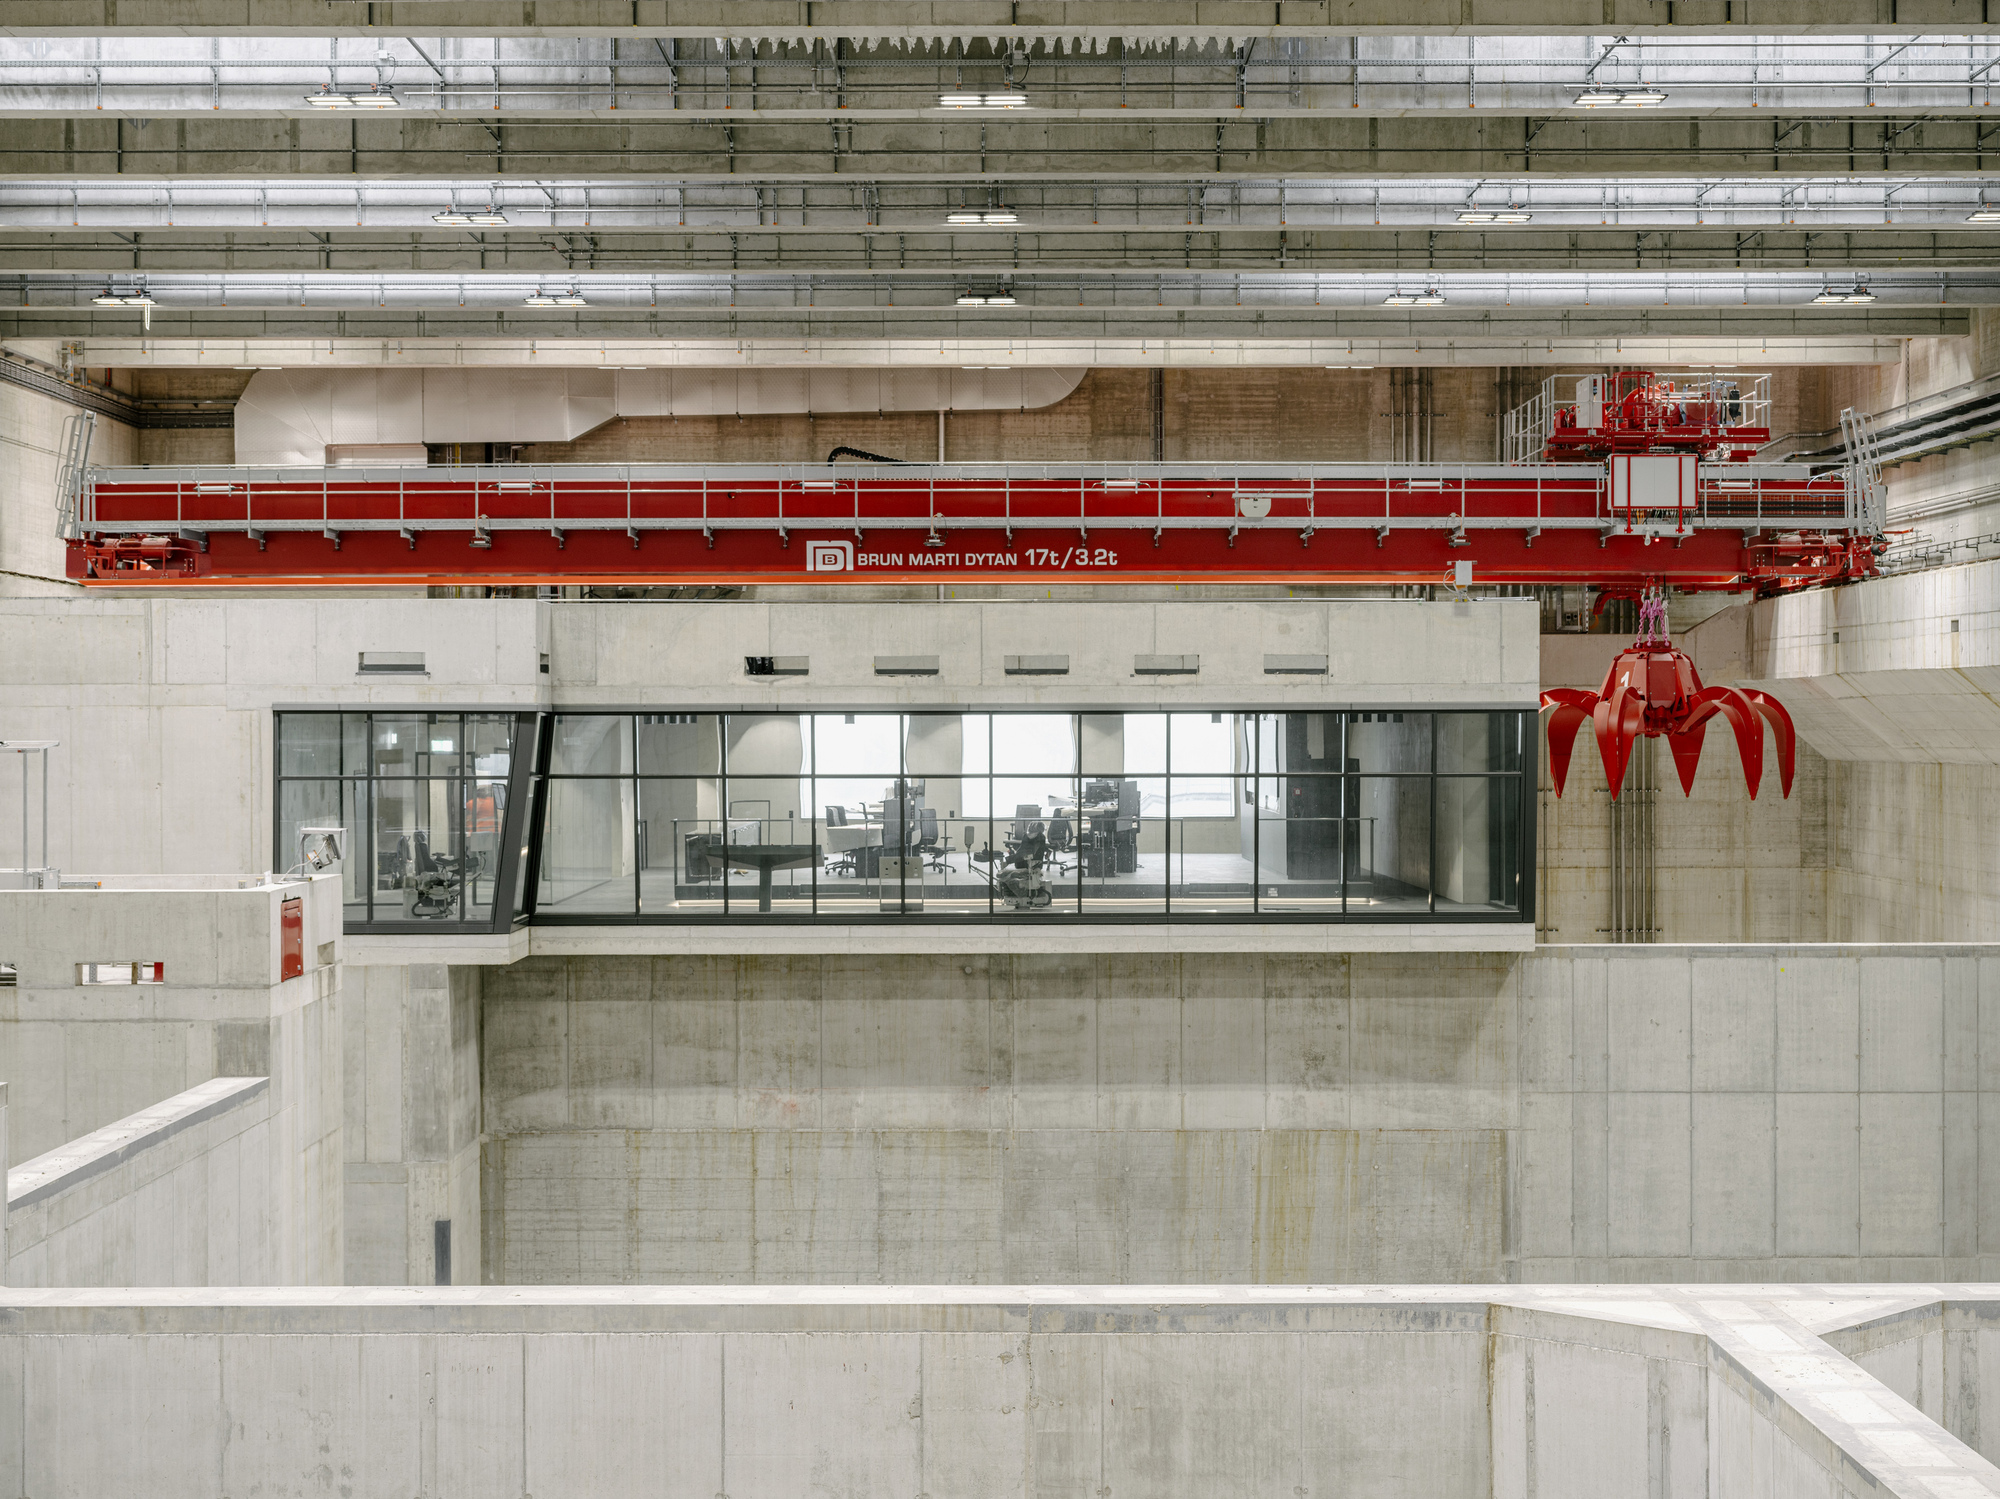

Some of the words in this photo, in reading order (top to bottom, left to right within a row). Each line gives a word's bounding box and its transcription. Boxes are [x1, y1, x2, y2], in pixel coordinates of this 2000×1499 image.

[857, 553, 903, 566] BRUN
[908, 553, 960, 566] MARTI
[965, 553, 1018, 566] DYTAN
[1620, 671, 1630, 687] 1
